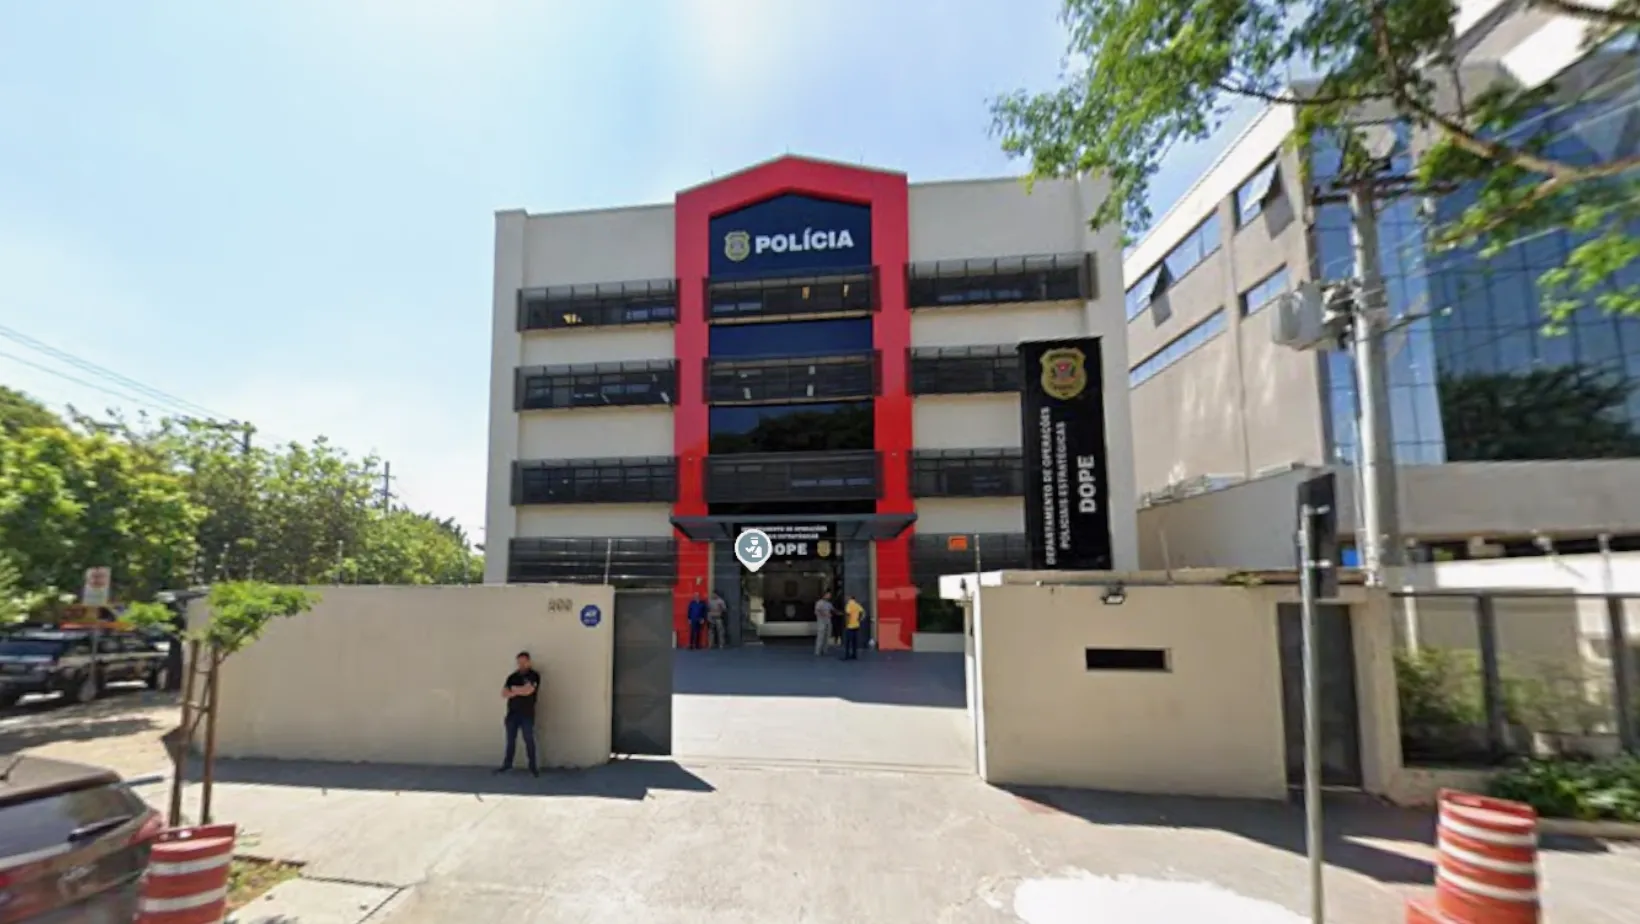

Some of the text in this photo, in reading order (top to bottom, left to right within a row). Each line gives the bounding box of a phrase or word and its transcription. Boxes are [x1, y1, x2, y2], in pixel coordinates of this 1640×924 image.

[755, 227, 854, 254] POLÍCIA
[1042, 469, 1053, 482] DE
[1077, 455, 1097, 513] DOPE
[1043, 485, 1055, 566] DEPARTAMENTO
[771, 543, 808, 556] OPE
